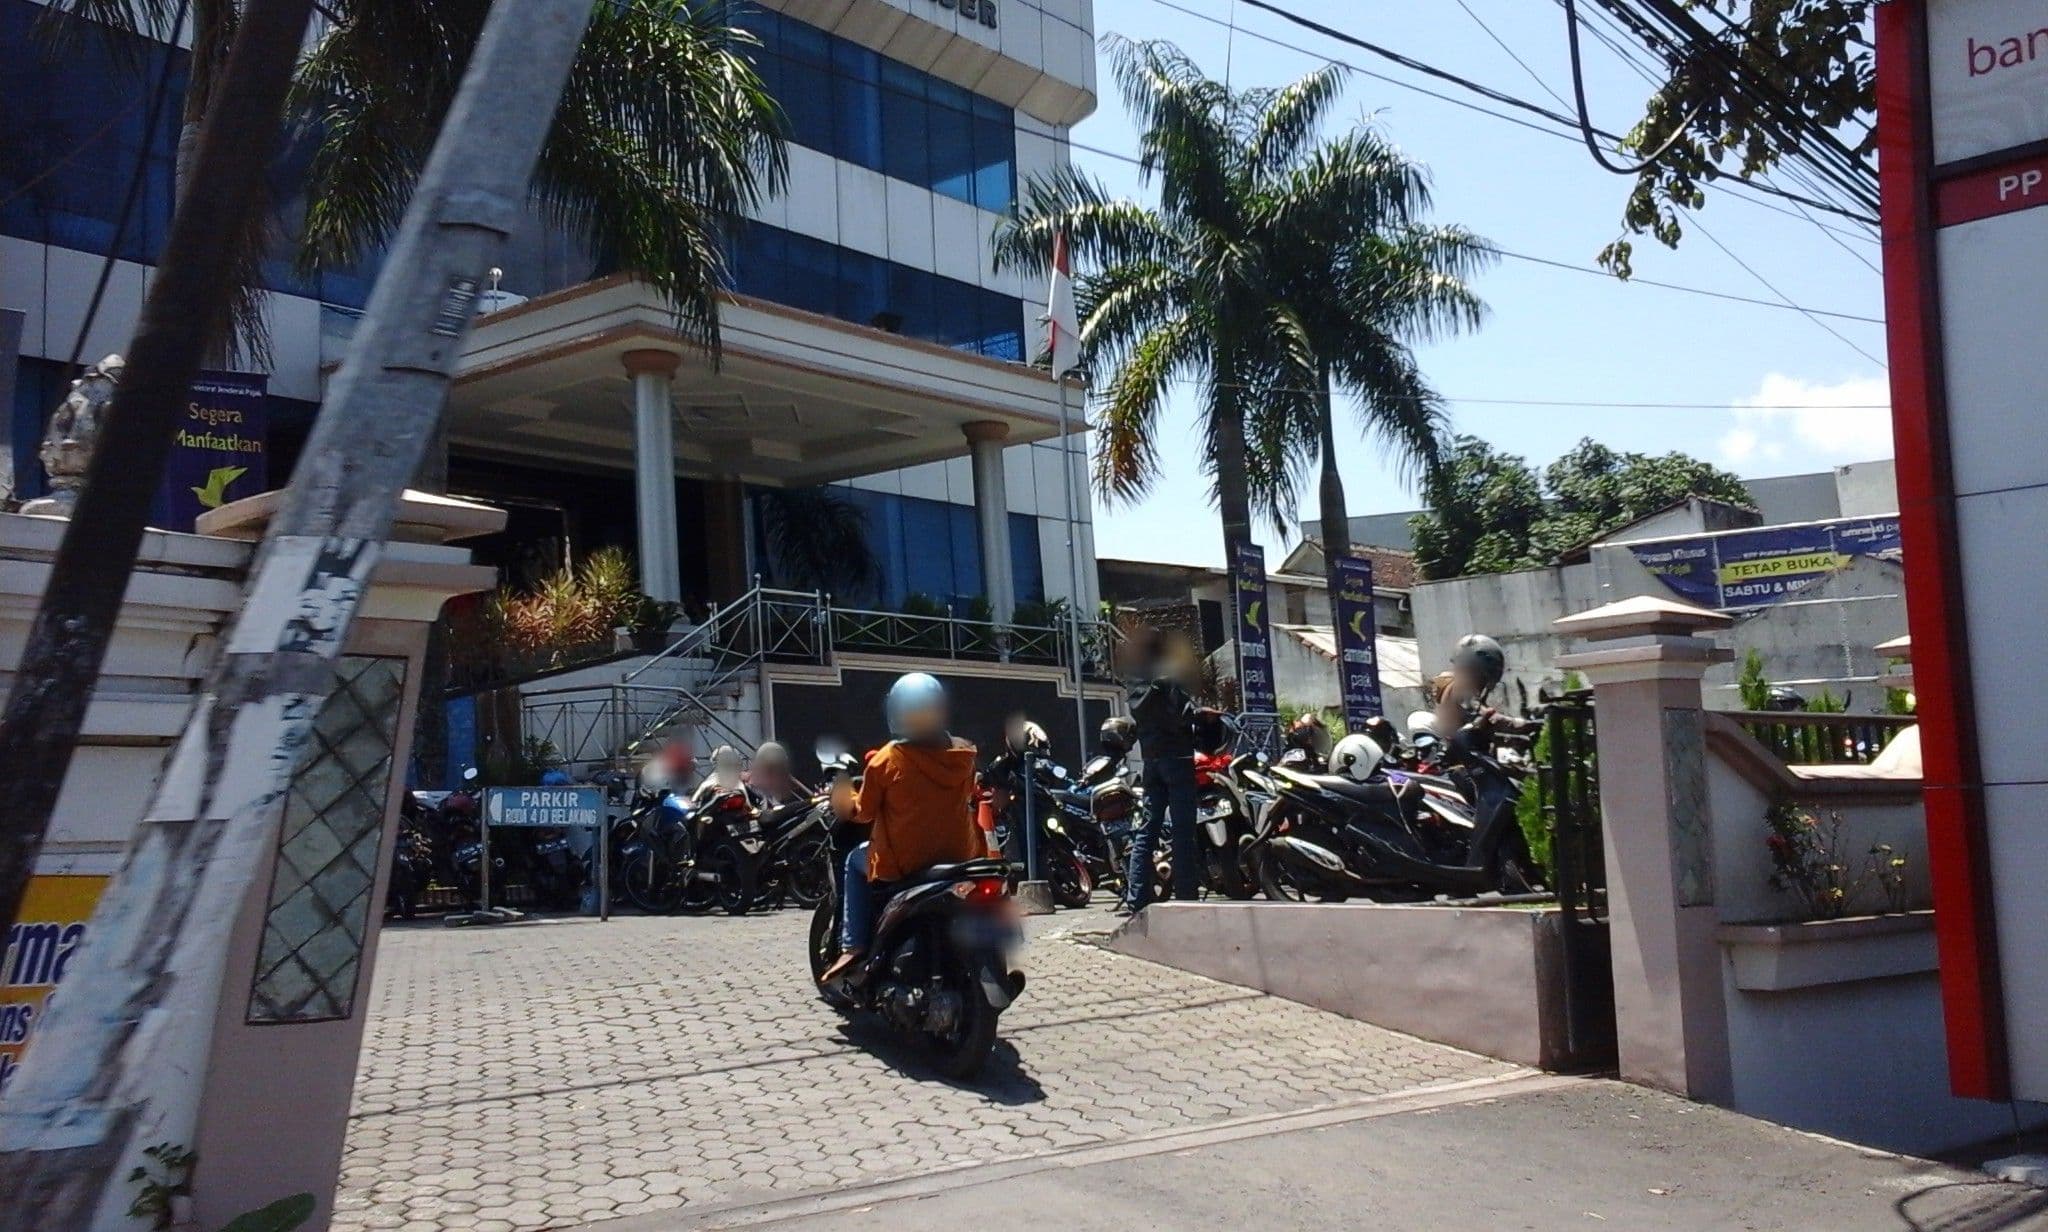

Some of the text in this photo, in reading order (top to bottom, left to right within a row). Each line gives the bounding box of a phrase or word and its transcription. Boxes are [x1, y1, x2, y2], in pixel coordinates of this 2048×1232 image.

[189, 402, 242, 426] Segera
[1732, 557, 1834, 576] TETAP BUKA
[1725, 583, 1771, 597] SABTU
[1774, 583, 1783, 592] &
[521, 792, 578, 807] PARKIR
